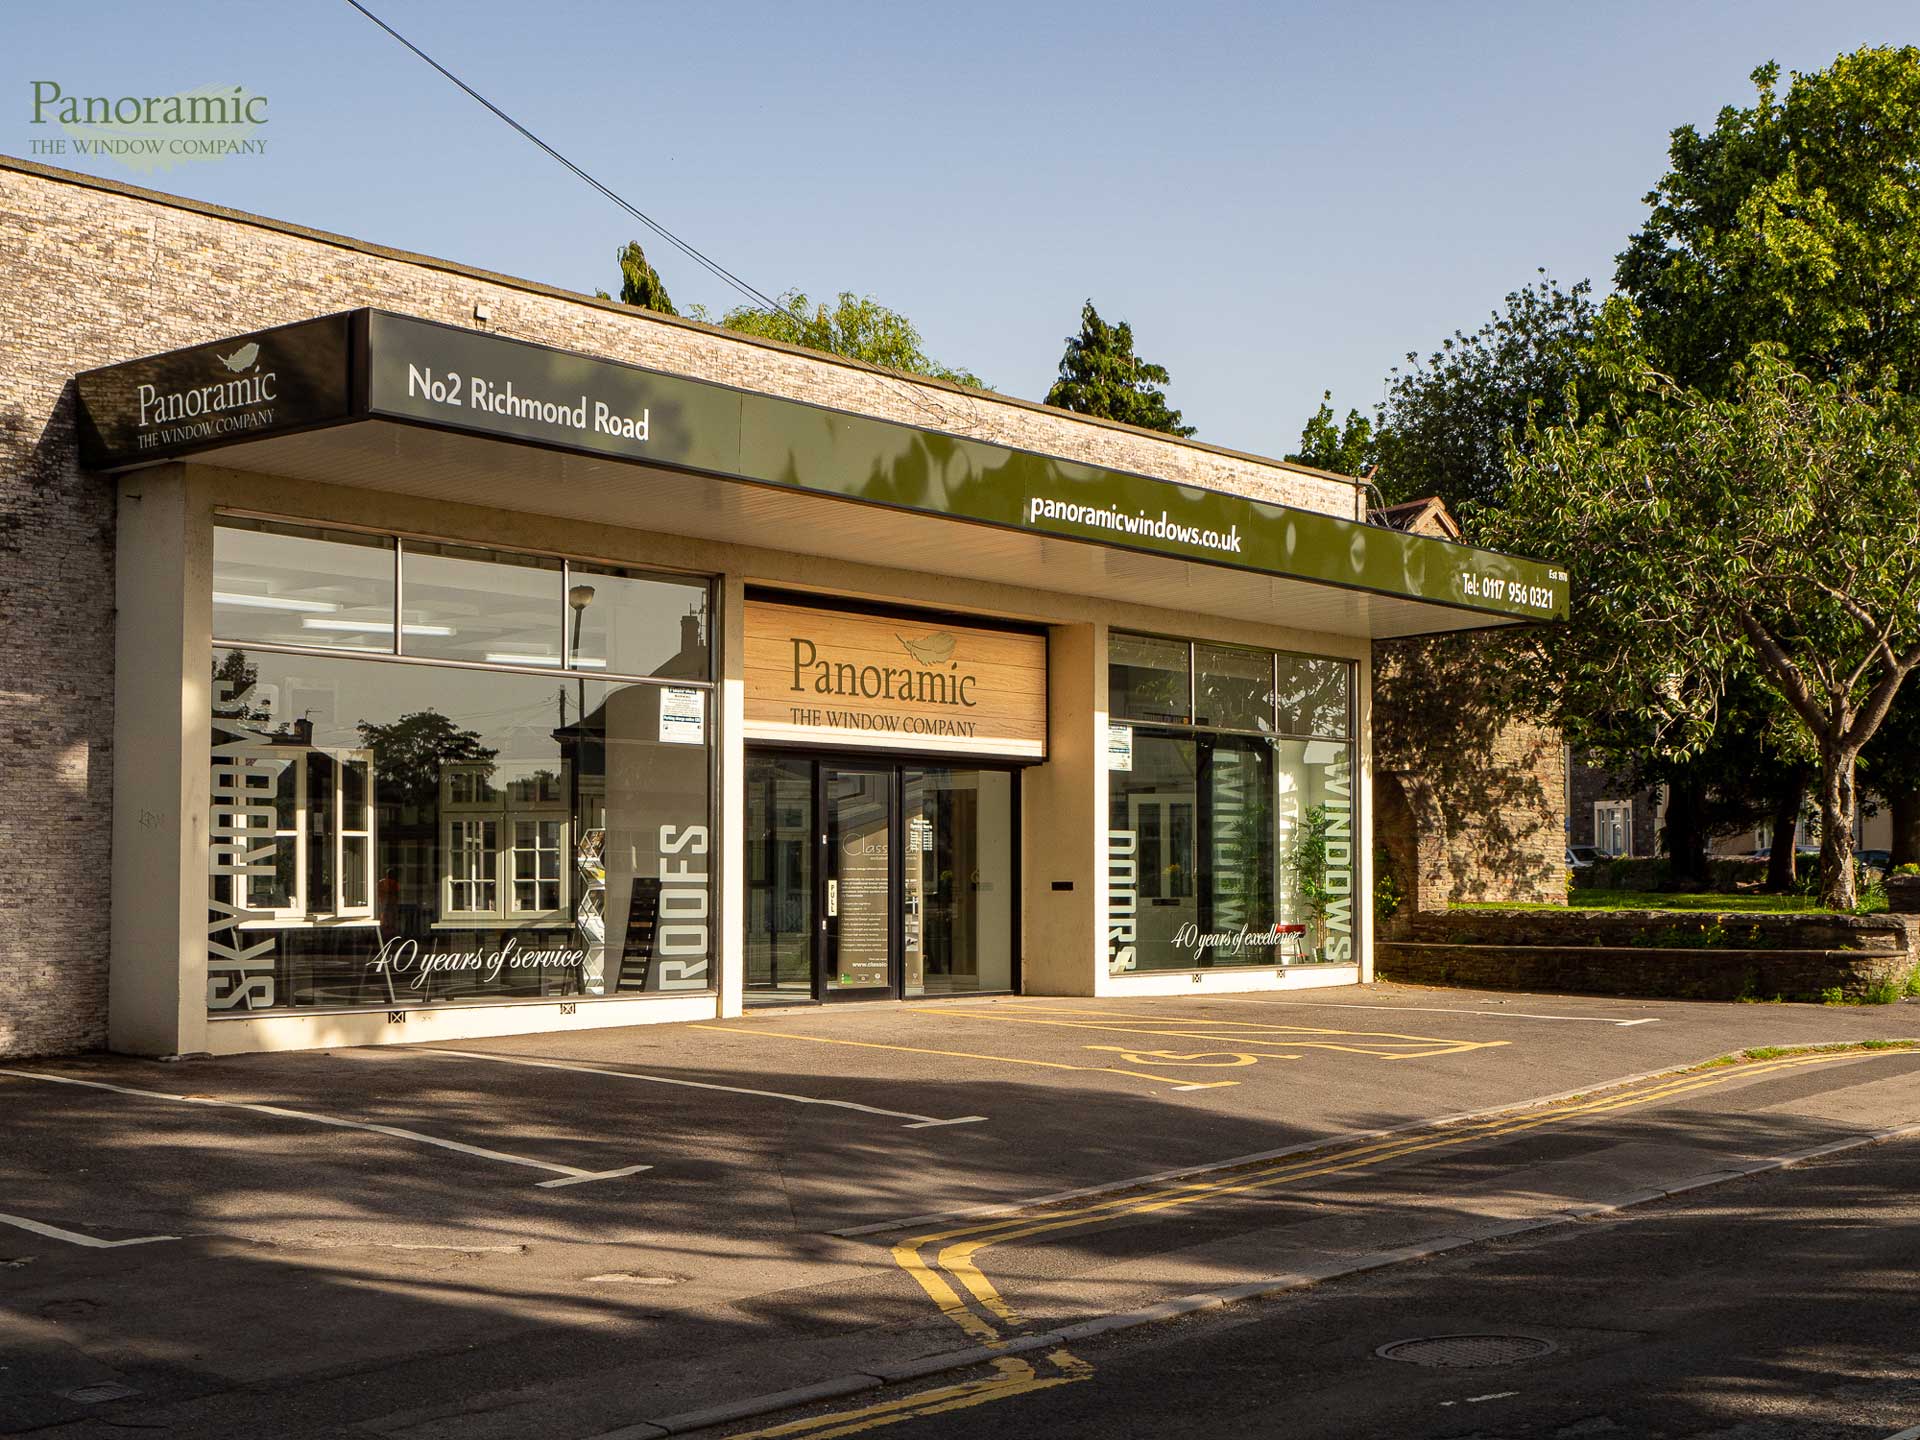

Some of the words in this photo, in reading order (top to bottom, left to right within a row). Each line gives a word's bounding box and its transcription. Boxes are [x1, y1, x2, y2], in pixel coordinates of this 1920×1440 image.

[137, 365, 277, 427] Panoramic
[138, 431, 159, 449] THE
[161, 420, 215, 444] WINDOW
[215, 408, 275, 434] COMPANY
[408, 363, 462, 406] No2
[471, 376, 587, 429] Richmond
[594, 401, 649, 441] Road
[1030, 497, 1242, 552] panoramicwindows.co.uk
[1462, 573, 1479, 596] Tel:
[1482, 577, 1505, 600] 0117
[1508, 581, 1528, 605] 956
[1529, 586, 1553, 609] 0321
[790, 637, 977, 707] Panoramic
[790, 707, 822, 727] THE
[826, 710, 900, 733] WINDOW
[903, 716, 977, 738] COMPANY
[209, 680, 279, 876] ROOMS
[1325, 761, 1352, 963] WINDOWS
[659, 824, 709, 991] ROOFS
[1109, 830, 1137, 971] DOORS
[208, 899, 276, 1010] SKY
[366, 936, 419, 973] 40
[411, 947, 482, 990] years
[484, 937, 518, 983] of
[510, 944, 584, 969] service
[1171, 921, 1198, 948] 40
[1194, 930, 1231, 960] years
[1231, 923, 1248, 955] of
